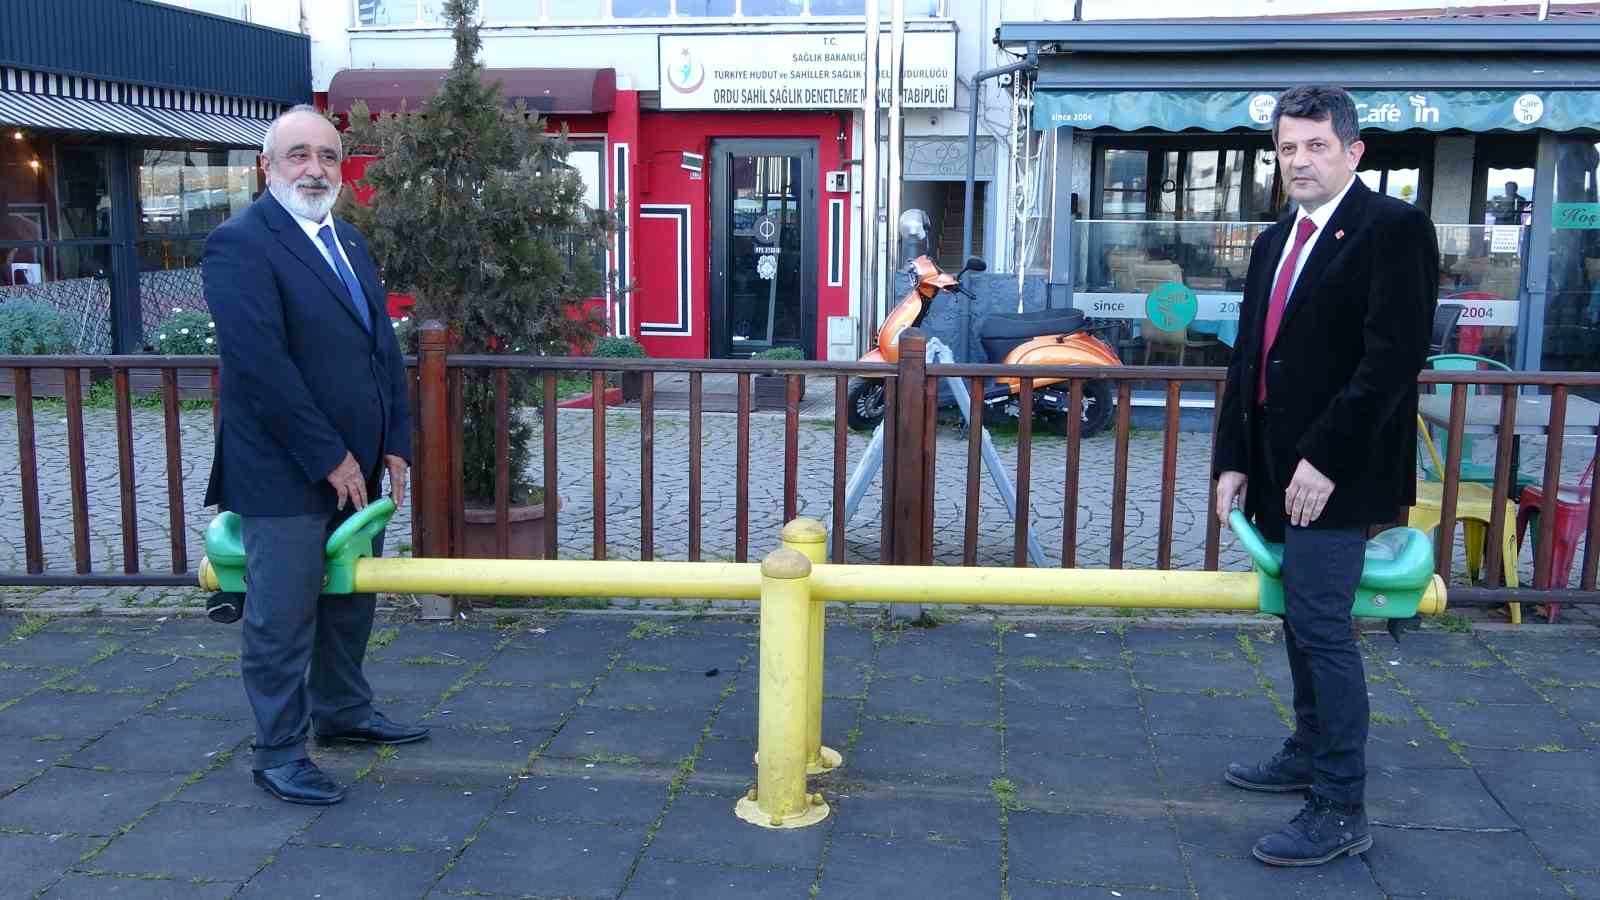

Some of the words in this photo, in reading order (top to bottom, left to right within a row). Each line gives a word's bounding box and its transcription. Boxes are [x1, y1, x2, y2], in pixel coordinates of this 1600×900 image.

[792, 51, 822, 62] SAĞLIK
[824, 52, 866, 62] BAKANLIĞ
[749, 69, 778, 80] HUDUT
[831, 68, 862, 79] SAĞLIK
[713, 88, 739, 104] ORDU
[741, 85, 768, 104] SAHİL
[769, 84, 803, 104] SAĞLIK
[805, 87, 859, 104] DENETLEME
[903, 84, 949, 104] TABİPLİĞİ
[1355, 103, 1401, 123] Café
[1412, 100, 1440, 123] in
[1093, 299, 1125, 312] since
[1462, 306, 1493, 319] 2004
